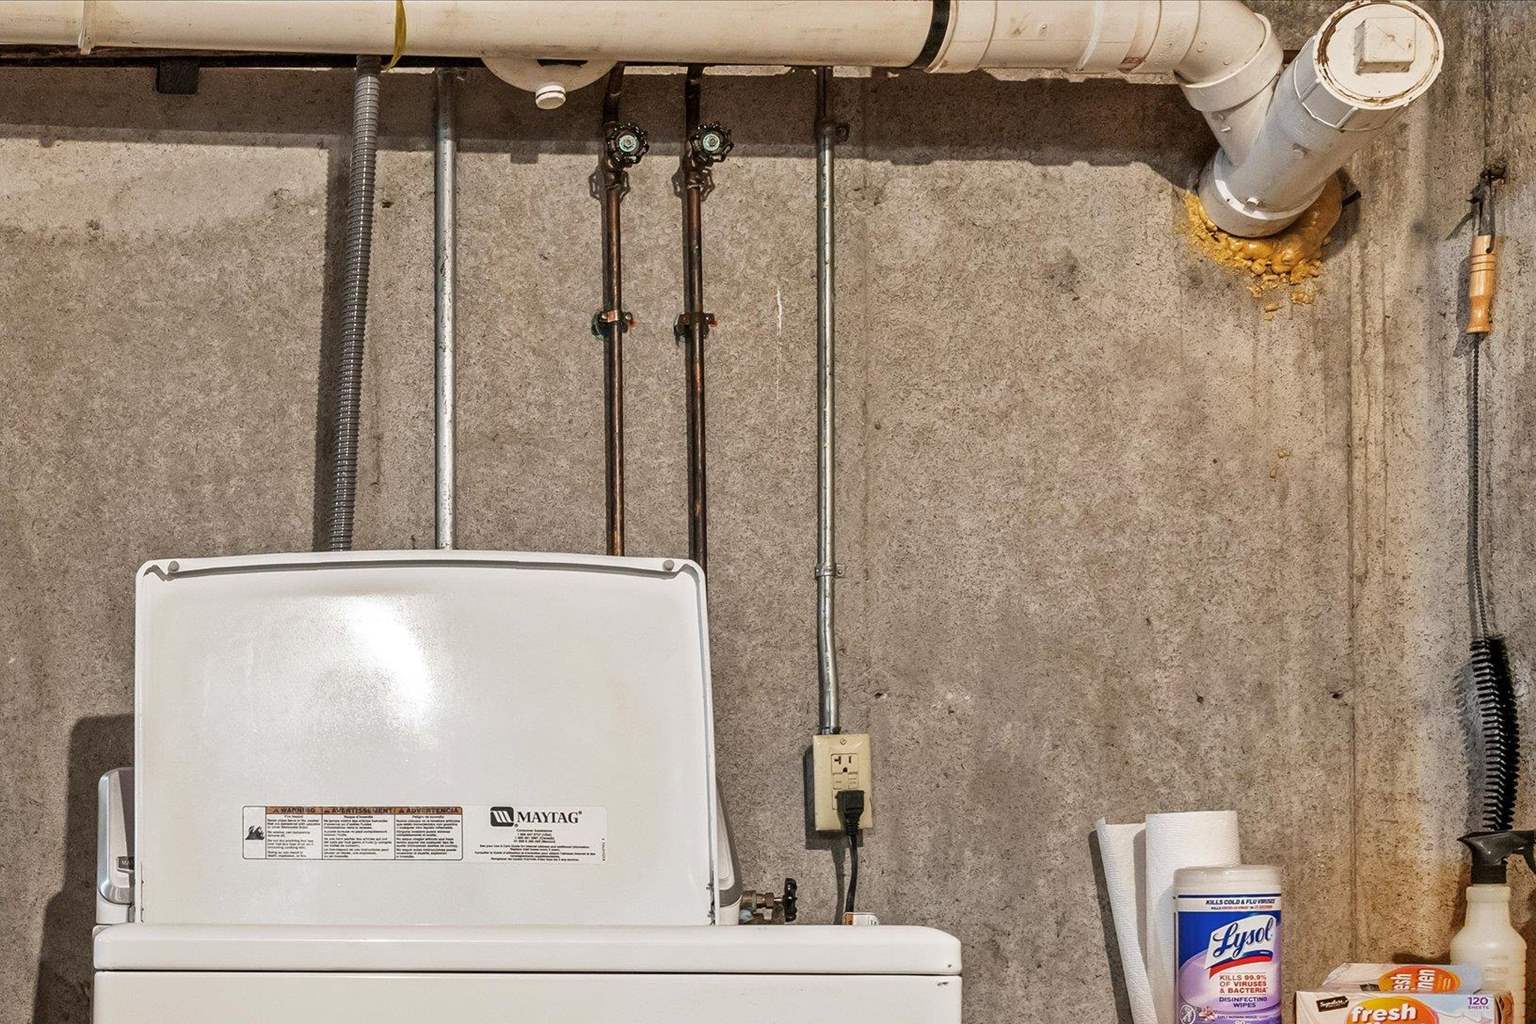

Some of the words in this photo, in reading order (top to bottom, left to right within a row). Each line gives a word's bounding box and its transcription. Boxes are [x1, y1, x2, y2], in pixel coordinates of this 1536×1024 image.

[517, 811, 580, 824] MAYTAG
[1212, 917, 1274, 958] Lysol
[1390, 973, 1412, 992] esh
[1467, 997, 1489, 1005] 120
[1351, 1003, 1417, 1023] fresh
